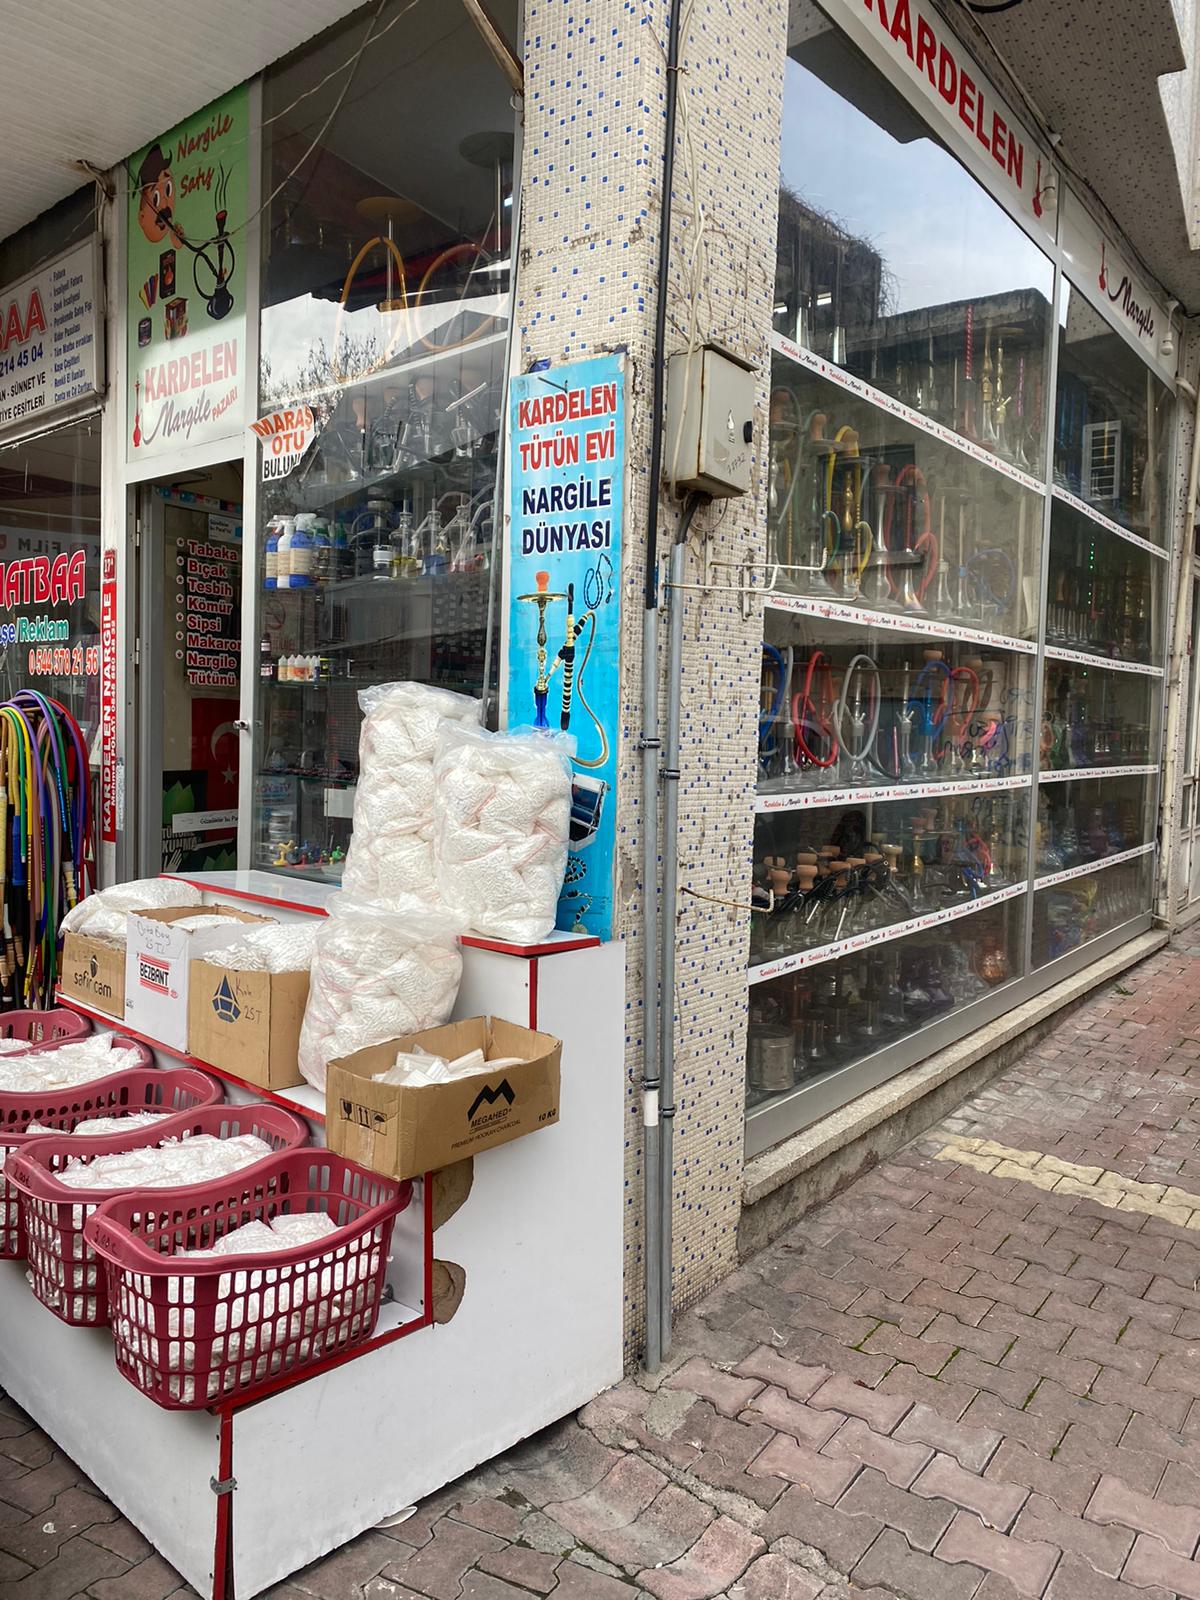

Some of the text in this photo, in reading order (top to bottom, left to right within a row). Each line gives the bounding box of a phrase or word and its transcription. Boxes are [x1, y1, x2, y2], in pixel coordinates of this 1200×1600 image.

[864, 0, 1023, 189] ARDELEN
[177, 112, 234, 162] Nargile
[0, 288, 47, 352] AA
[17, 349, 28, 368] 45
[31, 341, 43, 362] 04
[10, 375, 36, 398] SÜNNET
[36, 371, 46, 386] VE
[145, 341, 237, 403] KARDELEN
[13, 391, 45, 420] ÇEŞİTLERİ
[141, 386, 238, 445] Nargile PAZARI
[519, 383, 617, 428] KARDELEN
[252, 406, 312, 437] MARAŞ
[272, 431, 305, 455] OTU
[519, 421, 615, 471] TÜTÜN EVİ
[523, 475, 612, 515] NARGİLE
[187, 539, 238, 561] Tabaka
[522, 520, 611, 555] DÜNYASI
[187, 558, 227, 579] Bıçak
[187, 576, 233, 596] Tesbih
[187, 594, 233, 615] Kömür
[187, 613, 222, 633] Sipsi
[29, 647, 98, 675] 0 544 378 21 56
[187, 651, 237, 671] Nargile
[187, 669, 236, 687] Tütünü
[103, 705, 111, 833] KARDELEN
[140, 962, 169, 986] BEZBANT
[94, 981, 112, 998] cam
[538, 1114, 547, 1122] 10
